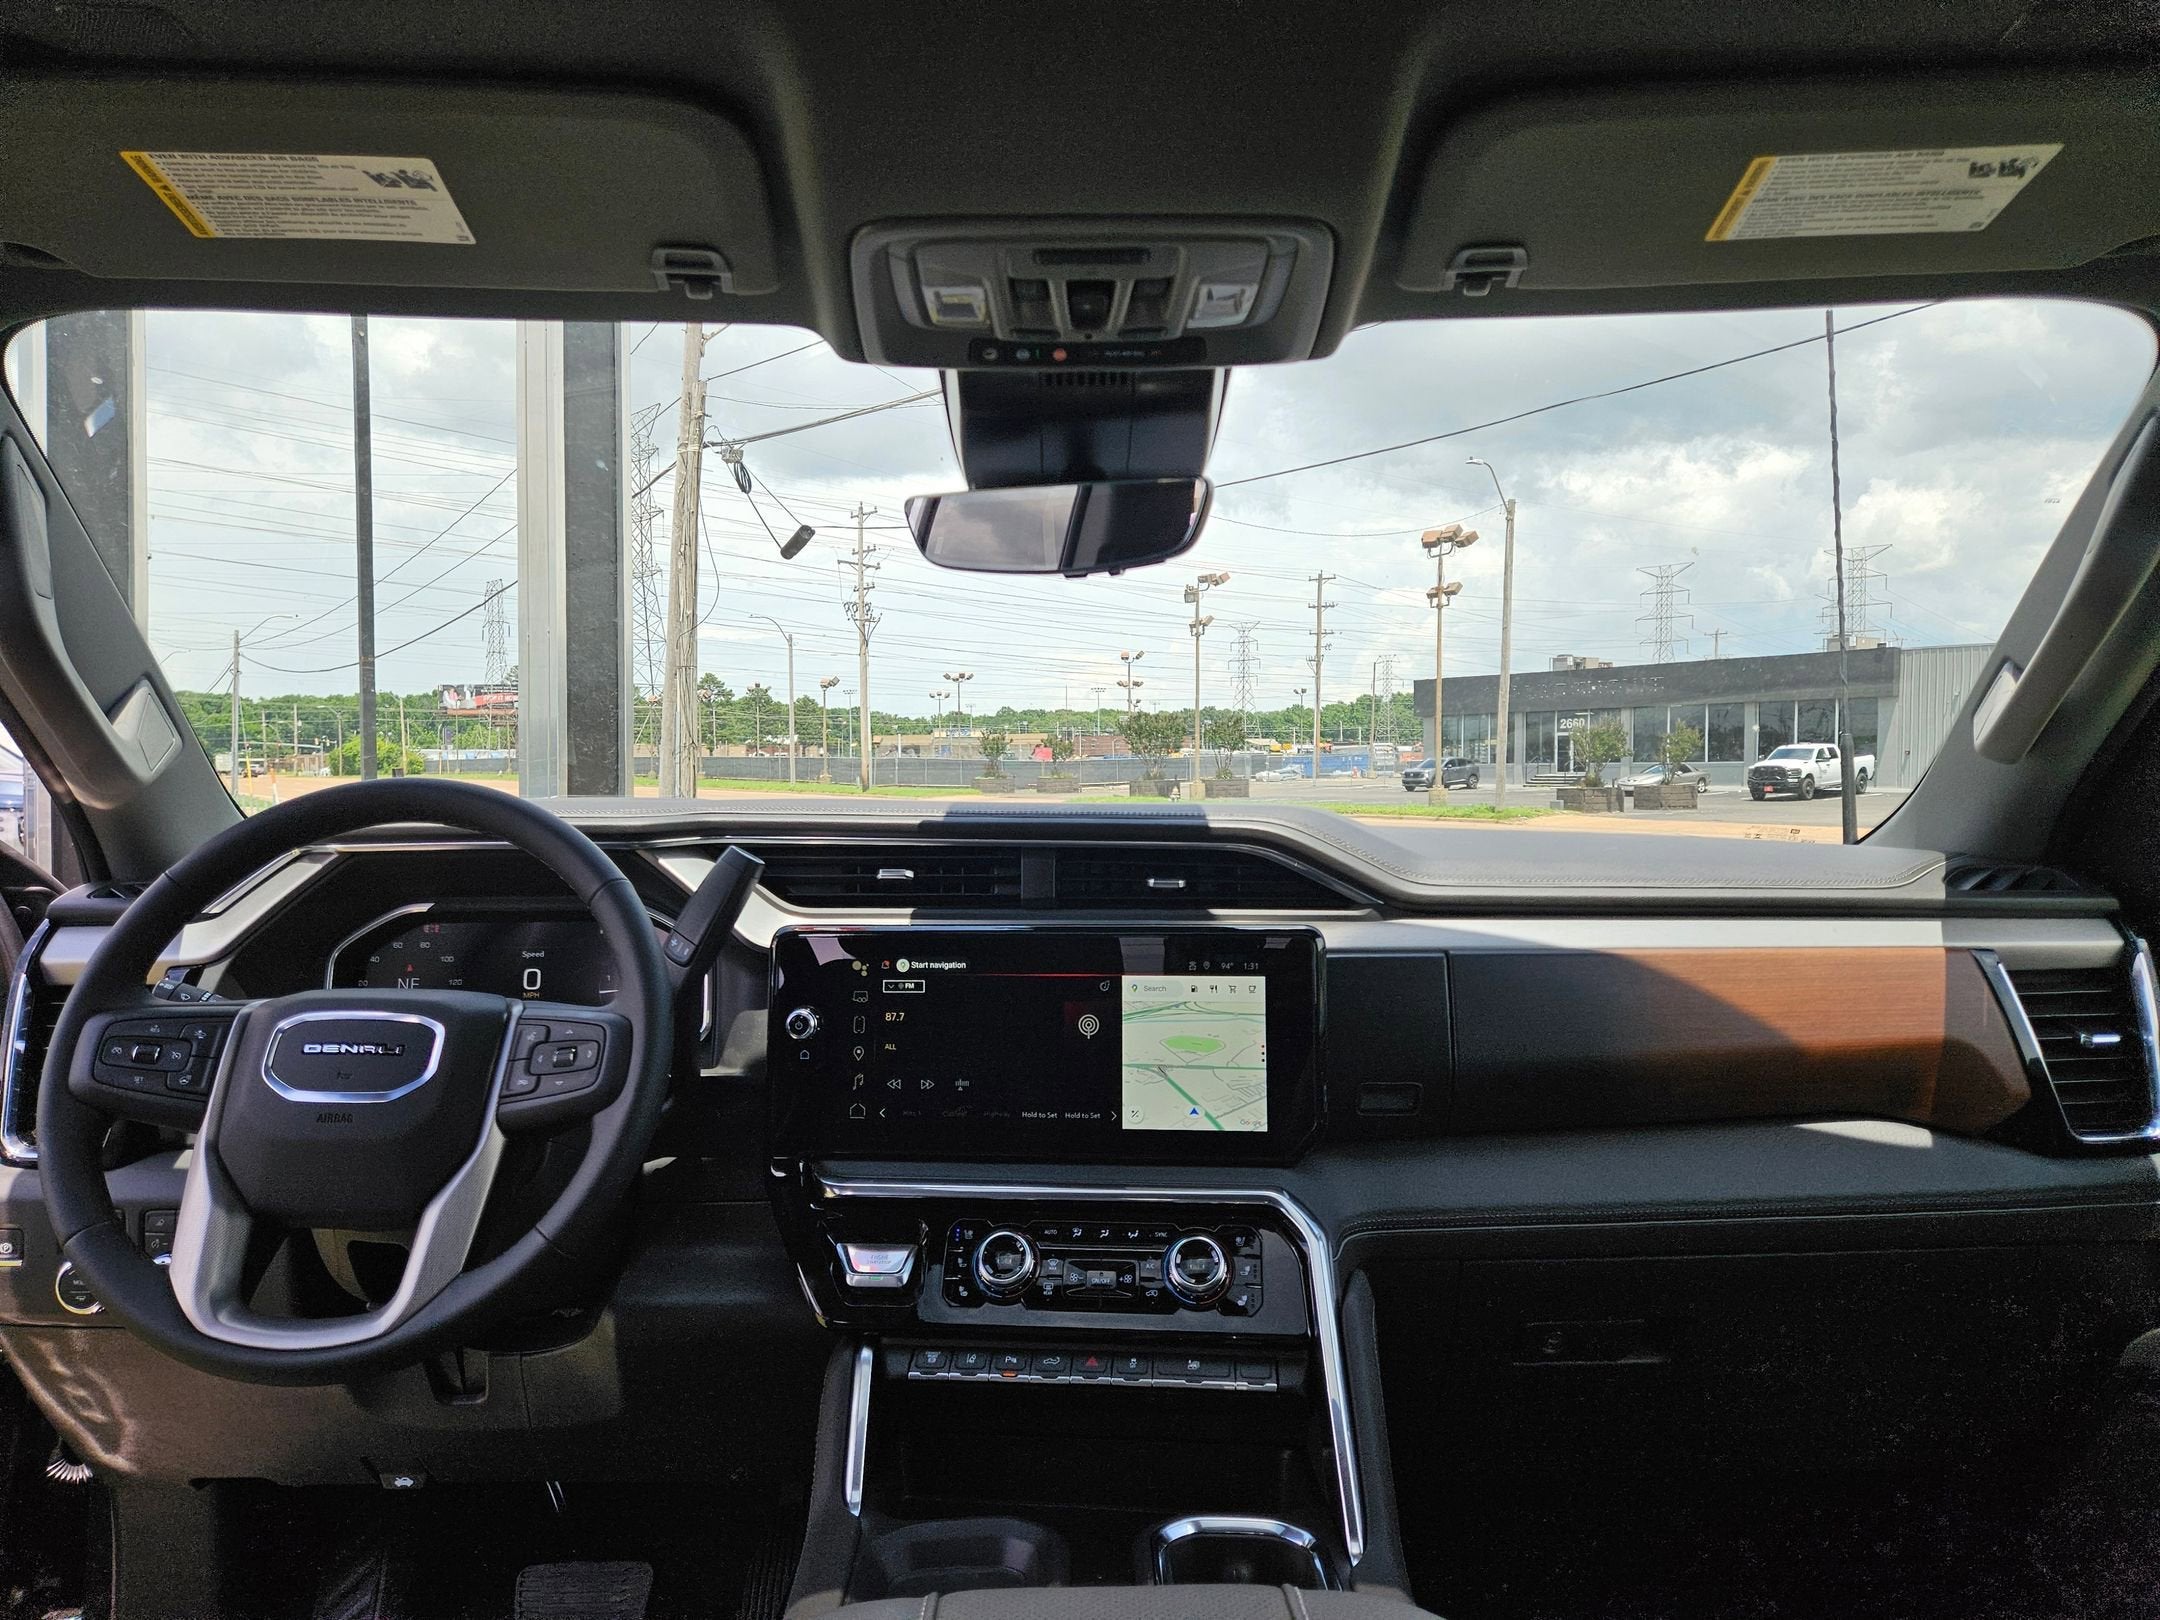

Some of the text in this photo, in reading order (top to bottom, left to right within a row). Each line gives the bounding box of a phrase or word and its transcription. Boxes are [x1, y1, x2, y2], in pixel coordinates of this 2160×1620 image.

[1559, 718, 1585, 729] 2660
[522, 951, 545, 959] Speed
[911, 960, 967, 972] Start navigation
[522, 968, 541, 990] 0
[1143, 984, 1167, 993] Search
[884, 1012, 905, 1022] 87.7
[303, 1043, 405, 1055] DENALI
[884, 1043, 897, 1051] ALL
[316, 1114, 353, 1124] AIRBAG
[1021, 1111, 1037, 1119] Hold
[1048, 1111, 1058, 1119] Set
[1065, 1111, 1101, 1120] Hold to Set
[1240, 1118, 1262, 1128] Google
